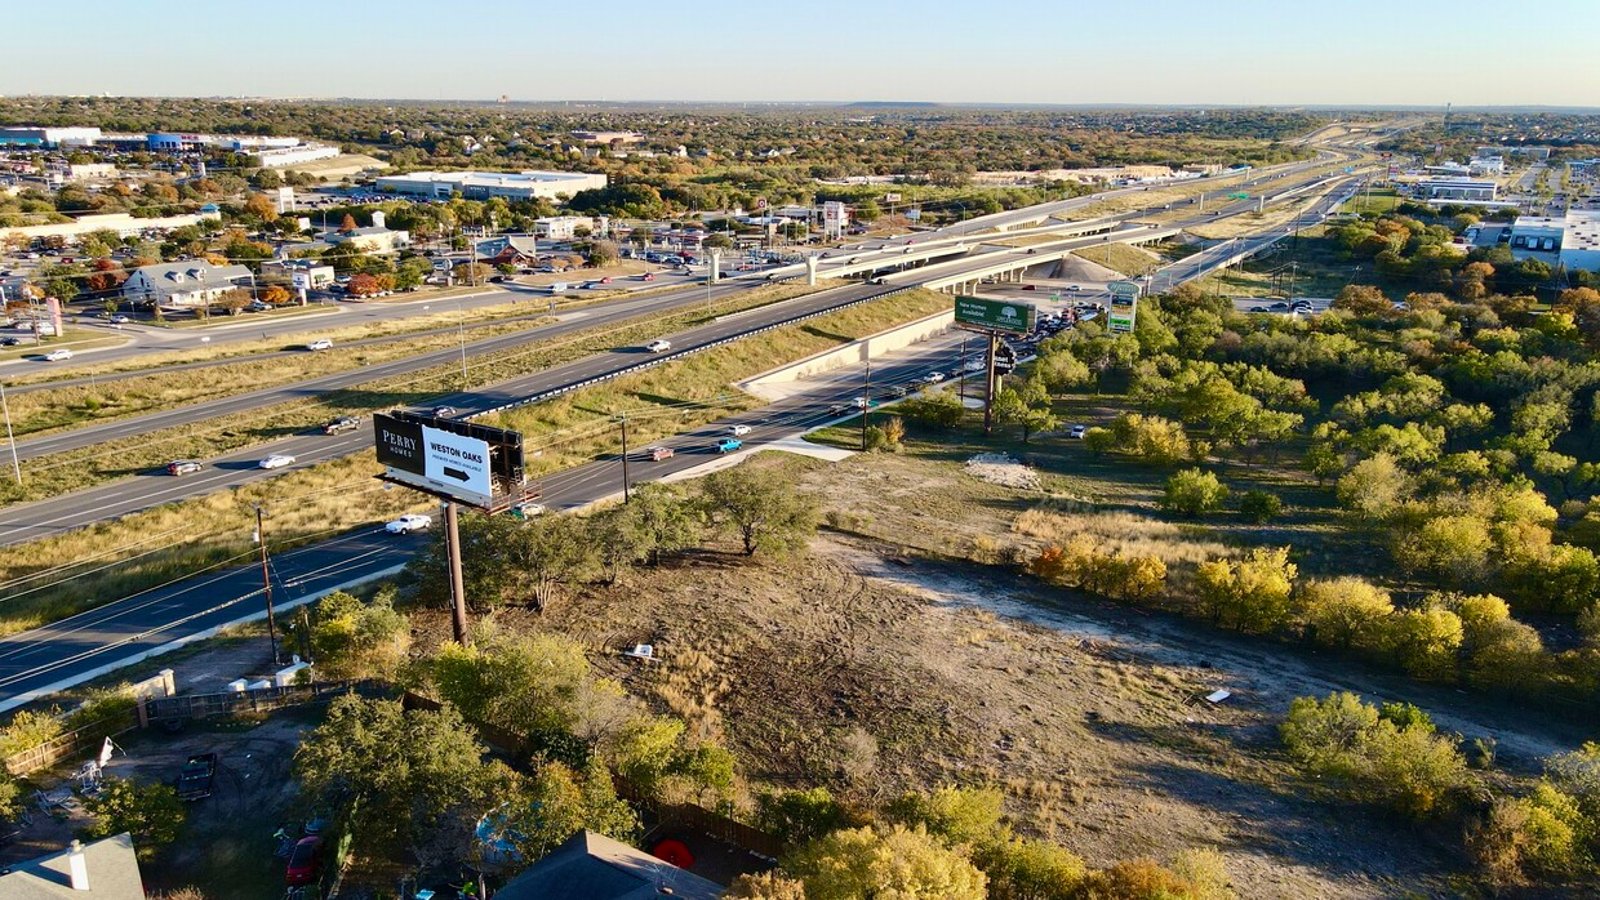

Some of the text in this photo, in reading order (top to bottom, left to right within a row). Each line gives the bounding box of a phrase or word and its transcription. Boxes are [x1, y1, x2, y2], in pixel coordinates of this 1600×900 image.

[383, 430, 416, 450] PERRY
[390, 446, 412, 457] HOMES
[430, 442, 482, 463] WESTON OAKS
